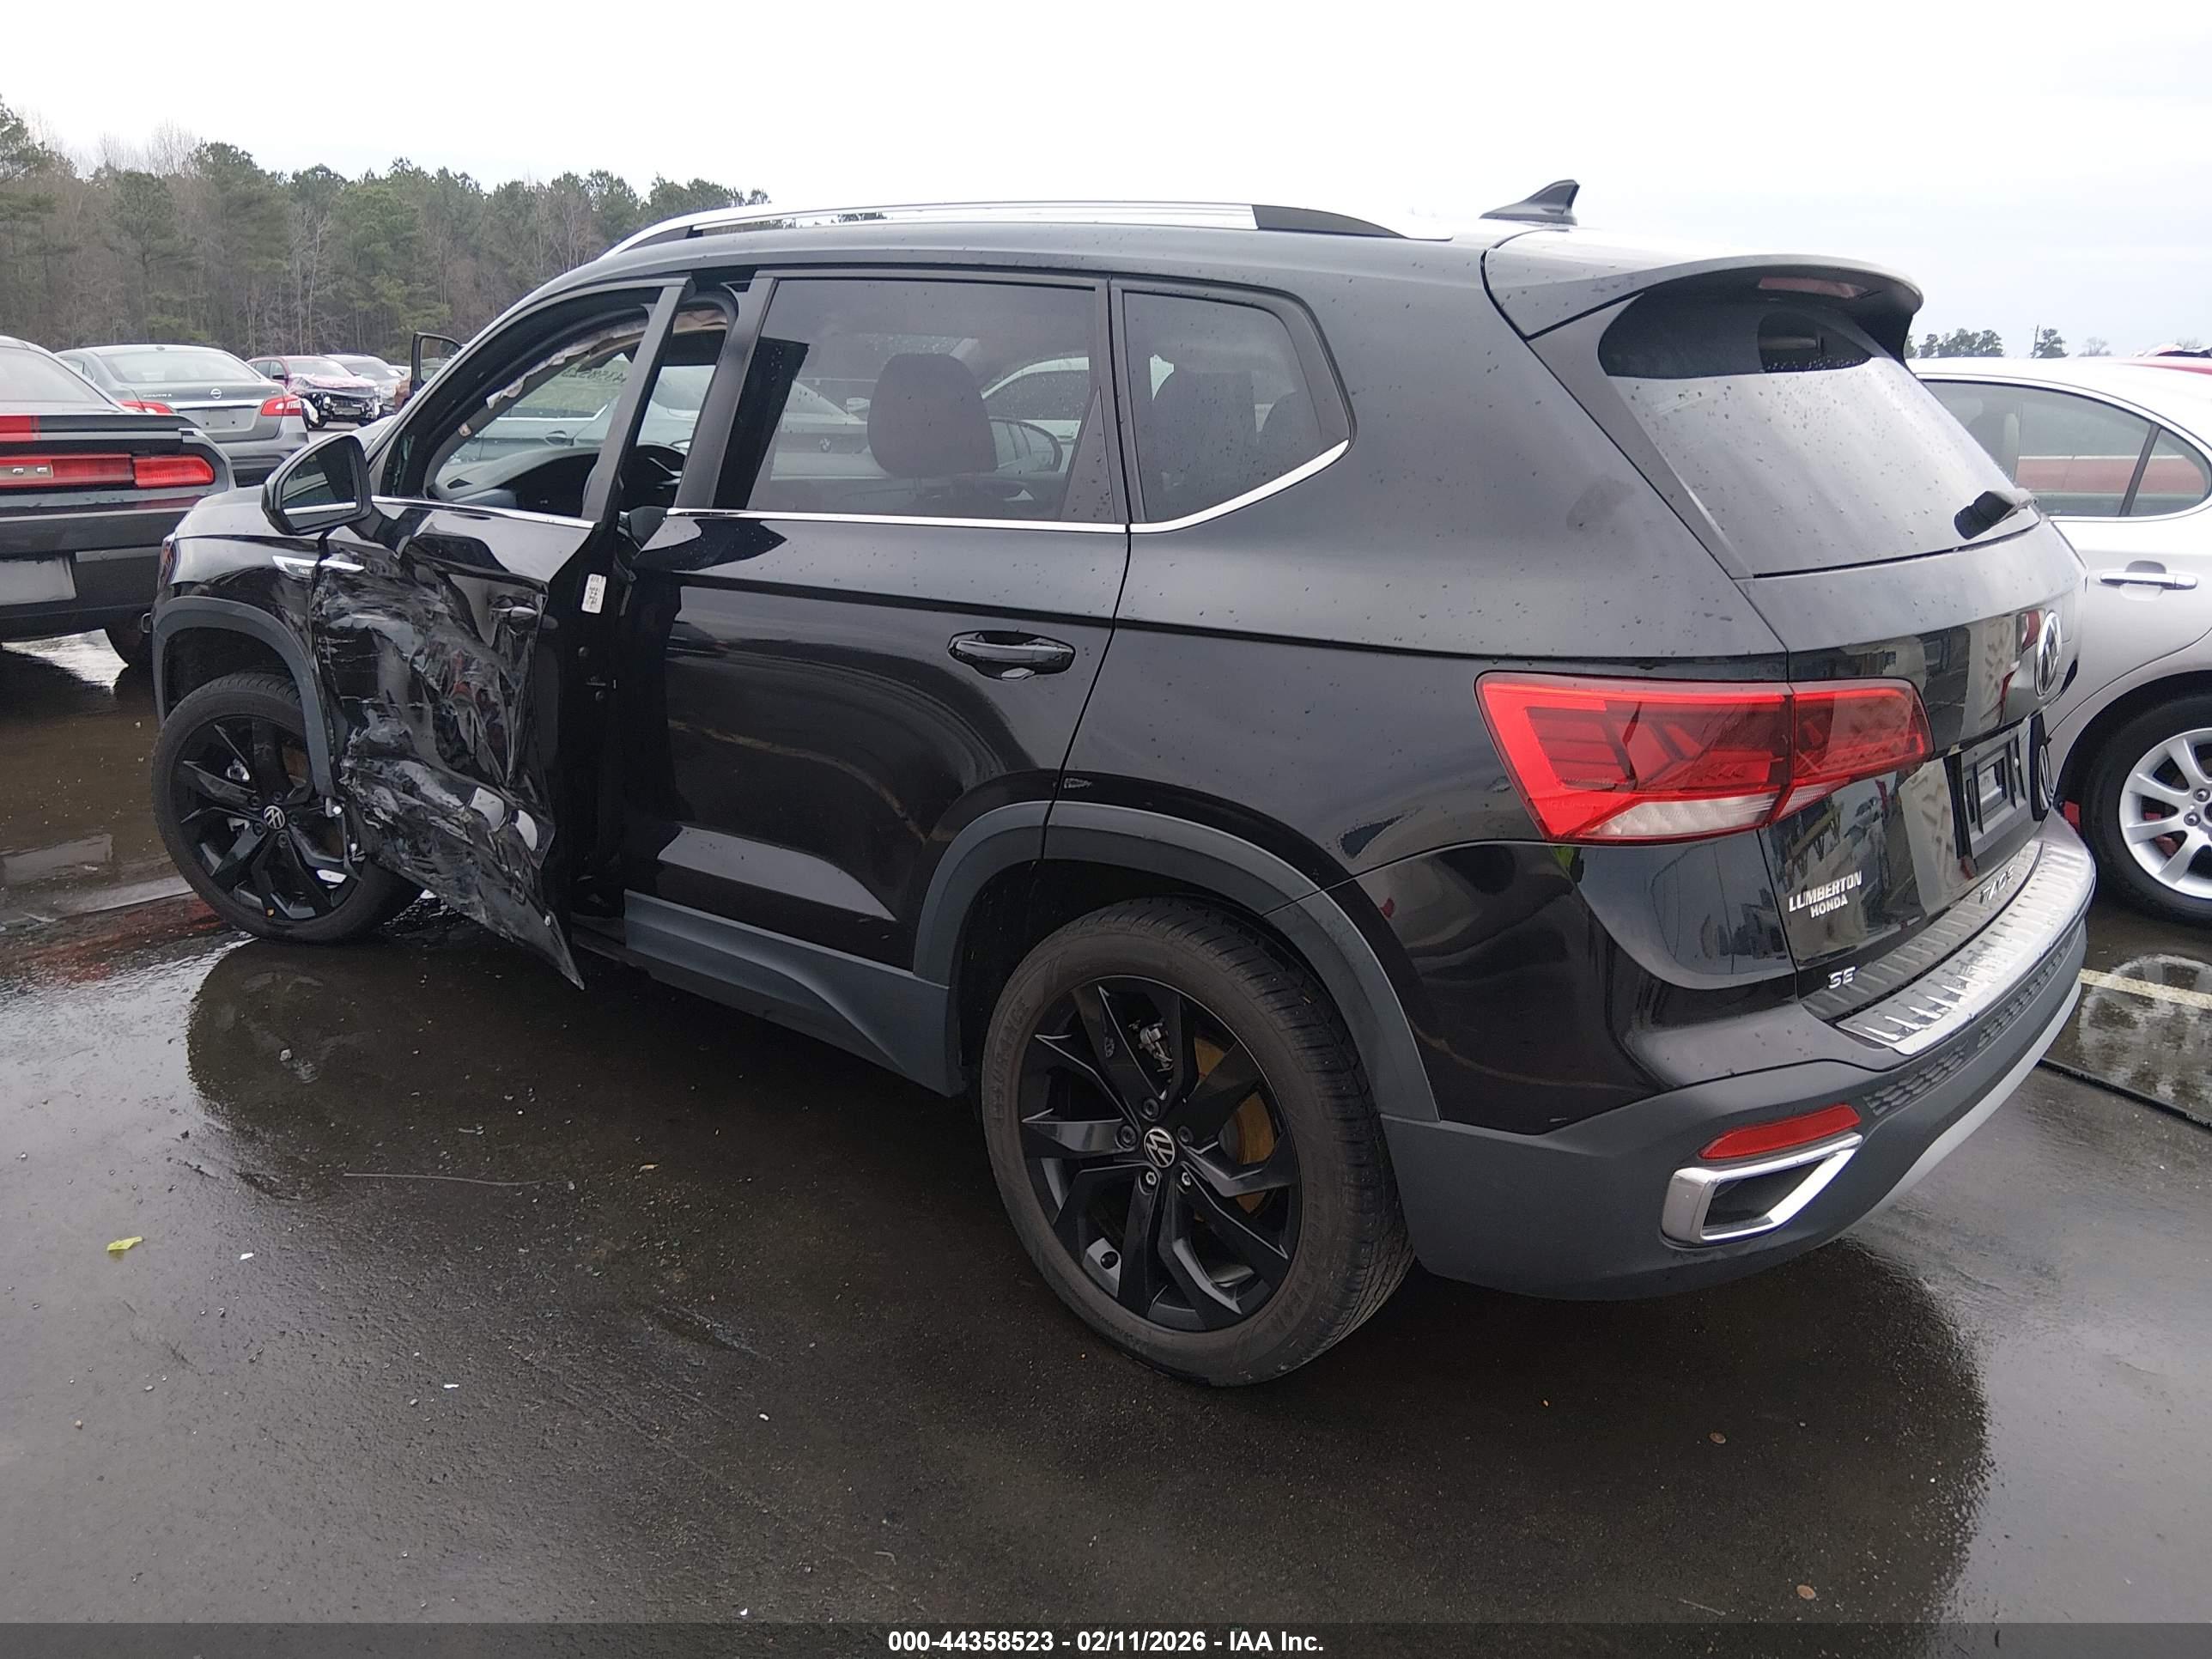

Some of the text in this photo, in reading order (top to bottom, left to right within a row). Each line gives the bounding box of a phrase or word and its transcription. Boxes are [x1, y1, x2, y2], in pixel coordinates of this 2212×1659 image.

[1789, 870, 1863, 913] LUMBERTON
[1810, 894, 1849, 919] HONDA
[1828, 966, 1856, 989] SE
